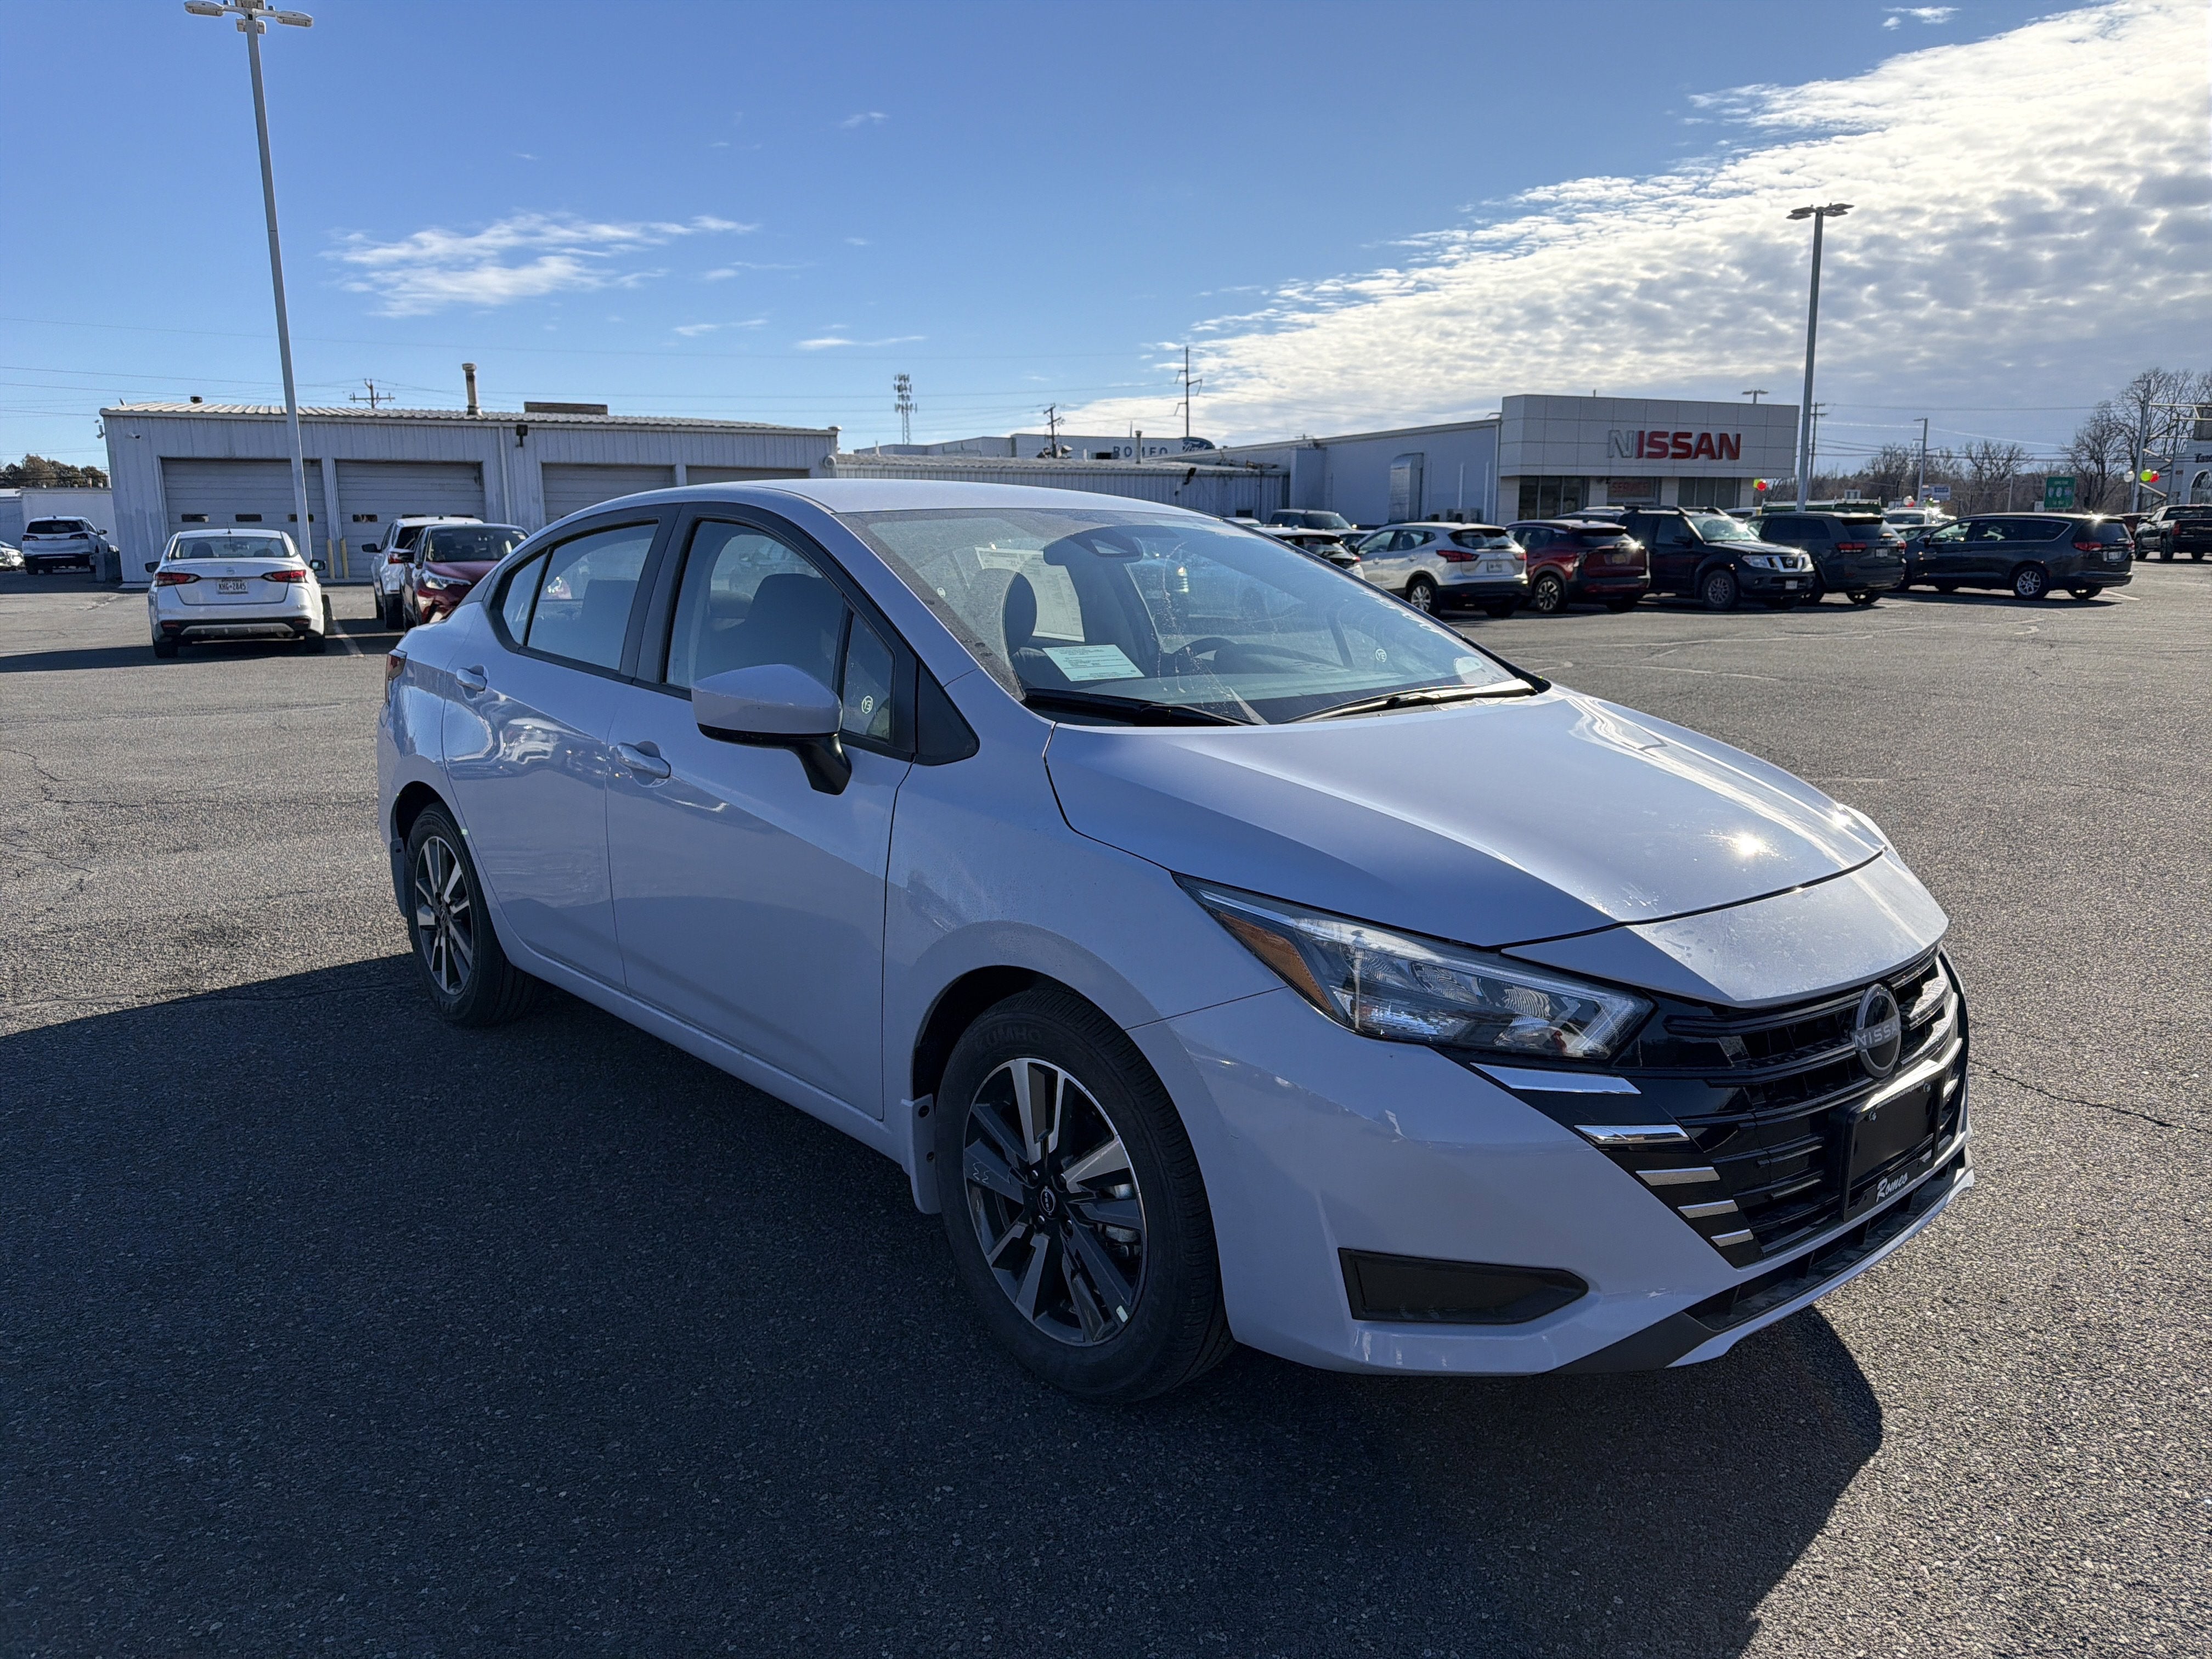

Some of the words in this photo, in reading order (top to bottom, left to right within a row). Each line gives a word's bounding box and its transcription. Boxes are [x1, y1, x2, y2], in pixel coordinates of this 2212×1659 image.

[1608, 430, 1741, 460] NISSAN
[1855, 1022, 1898, 1047] NISSA
[1876, 1172, 1909, 1203] Romeo
